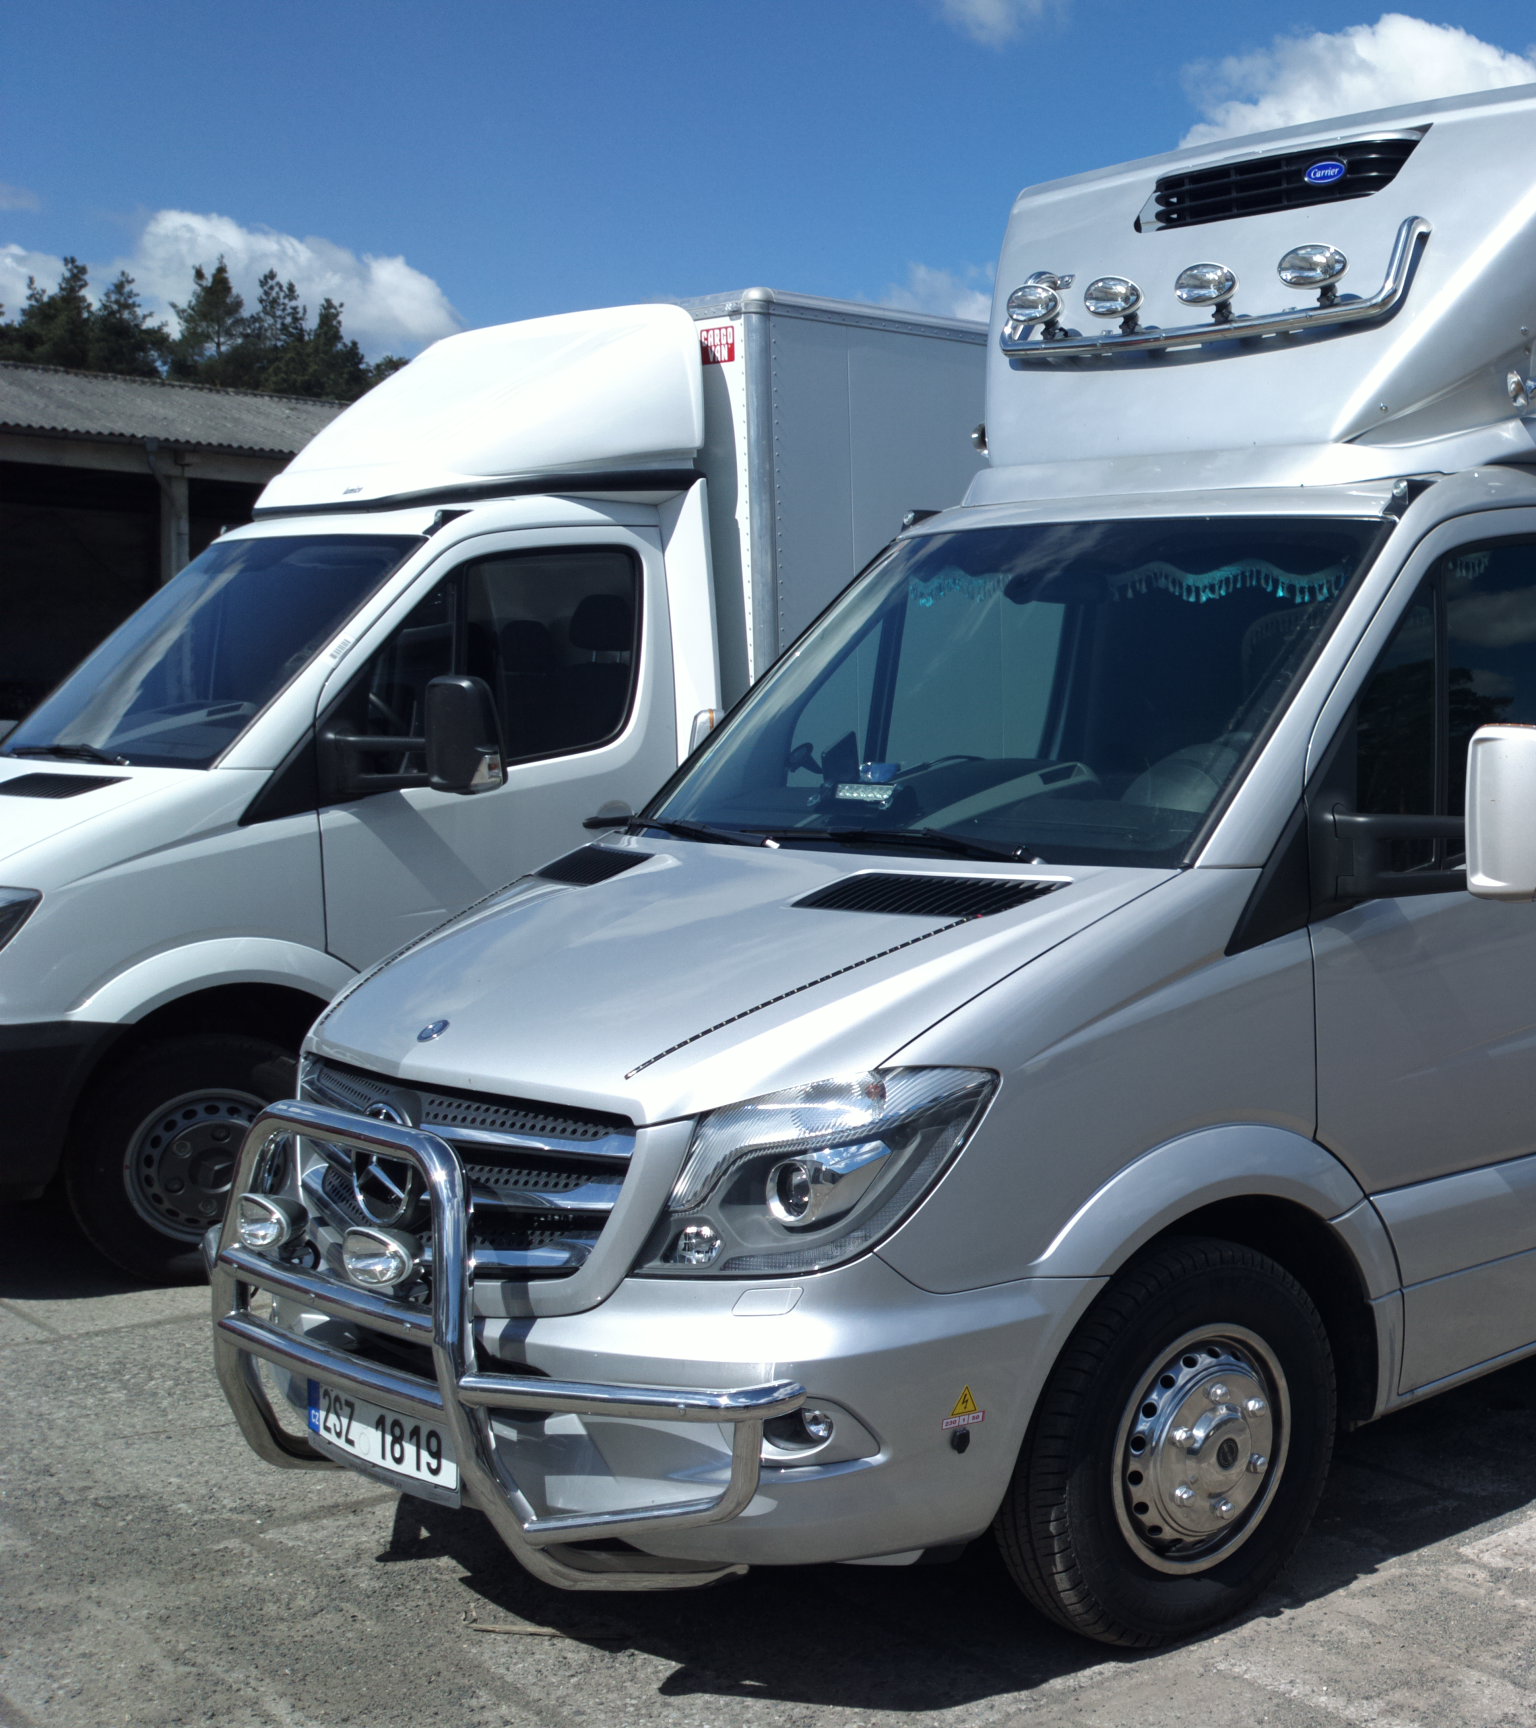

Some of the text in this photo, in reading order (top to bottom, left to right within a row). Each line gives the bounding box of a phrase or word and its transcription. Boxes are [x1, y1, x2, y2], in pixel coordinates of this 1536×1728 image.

[1310, 167, 1340, 178] Carrier
[701, 326, 733, 347] CARGO
[708, 344, 728, 363] VAN
[311, 1409, 320, 1425] CZ
[322, 1388, 443, 1477] 2SZ 1819
